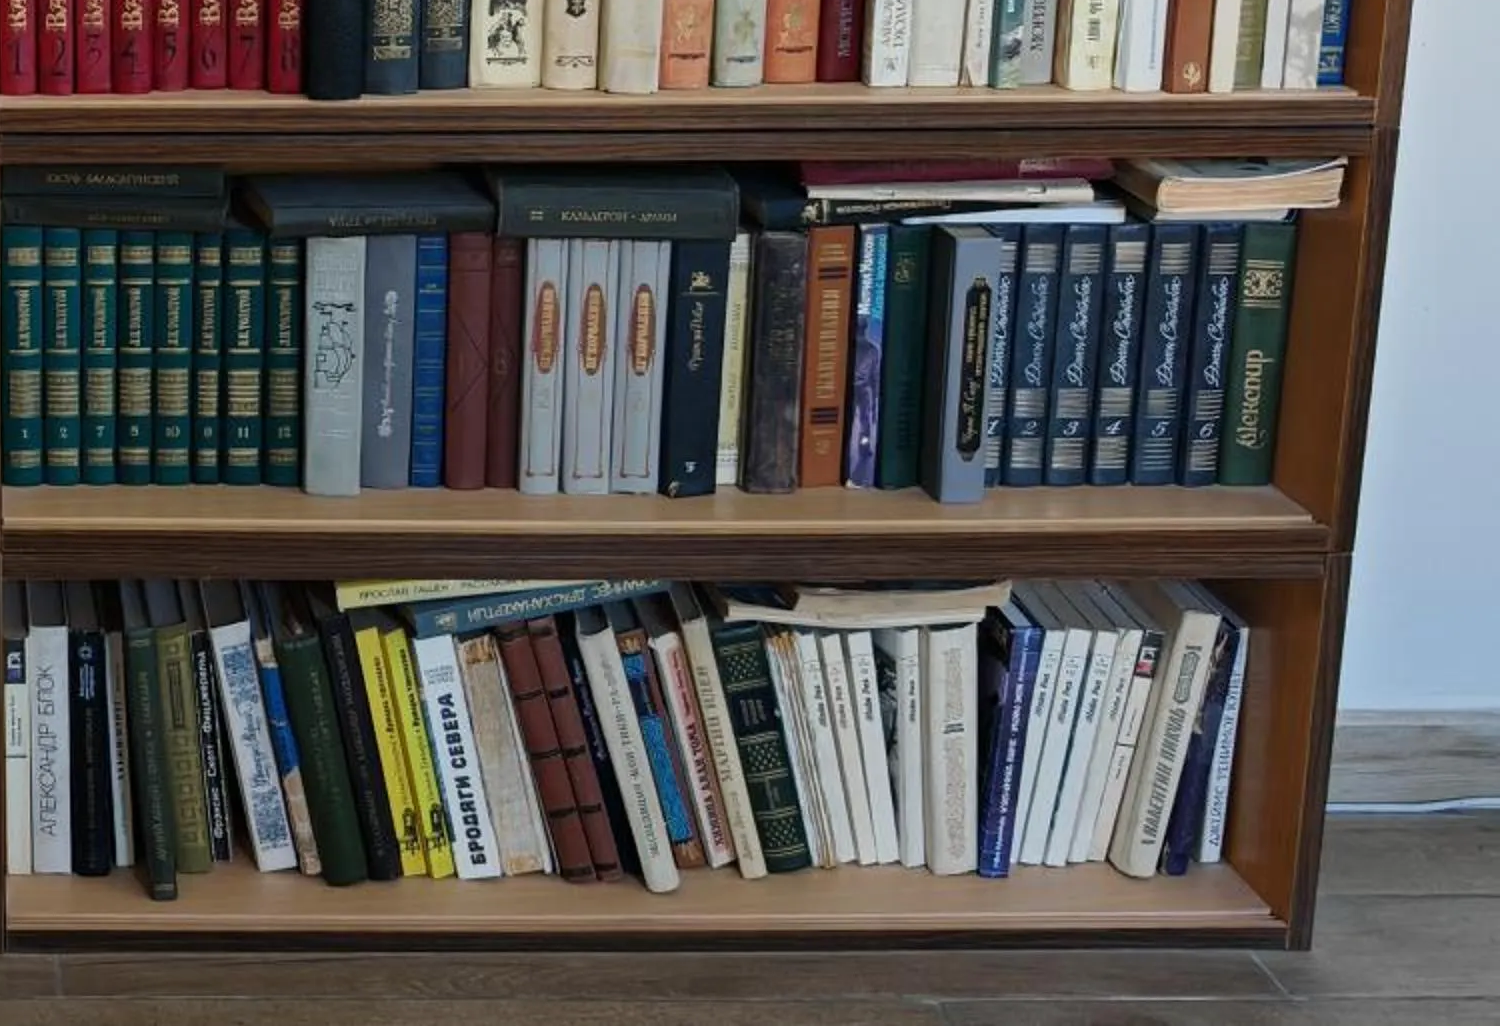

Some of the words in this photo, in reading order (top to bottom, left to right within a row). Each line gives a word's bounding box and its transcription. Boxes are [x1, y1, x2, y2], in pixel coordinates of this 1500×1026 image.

[1235, 349, 1275, 449] Шекспир
[35, 665, 57, 716] БЛОК
[436, 693, 468, 769] СЕВЕРА
[686, 722, 704, 755] ТОМА
[37, 722, 59, 837] АЛЕКСАНДР
[210, 787, 226, 840] Фрэнсис
[457, 775, 487, 865] БРОДЯГИ
